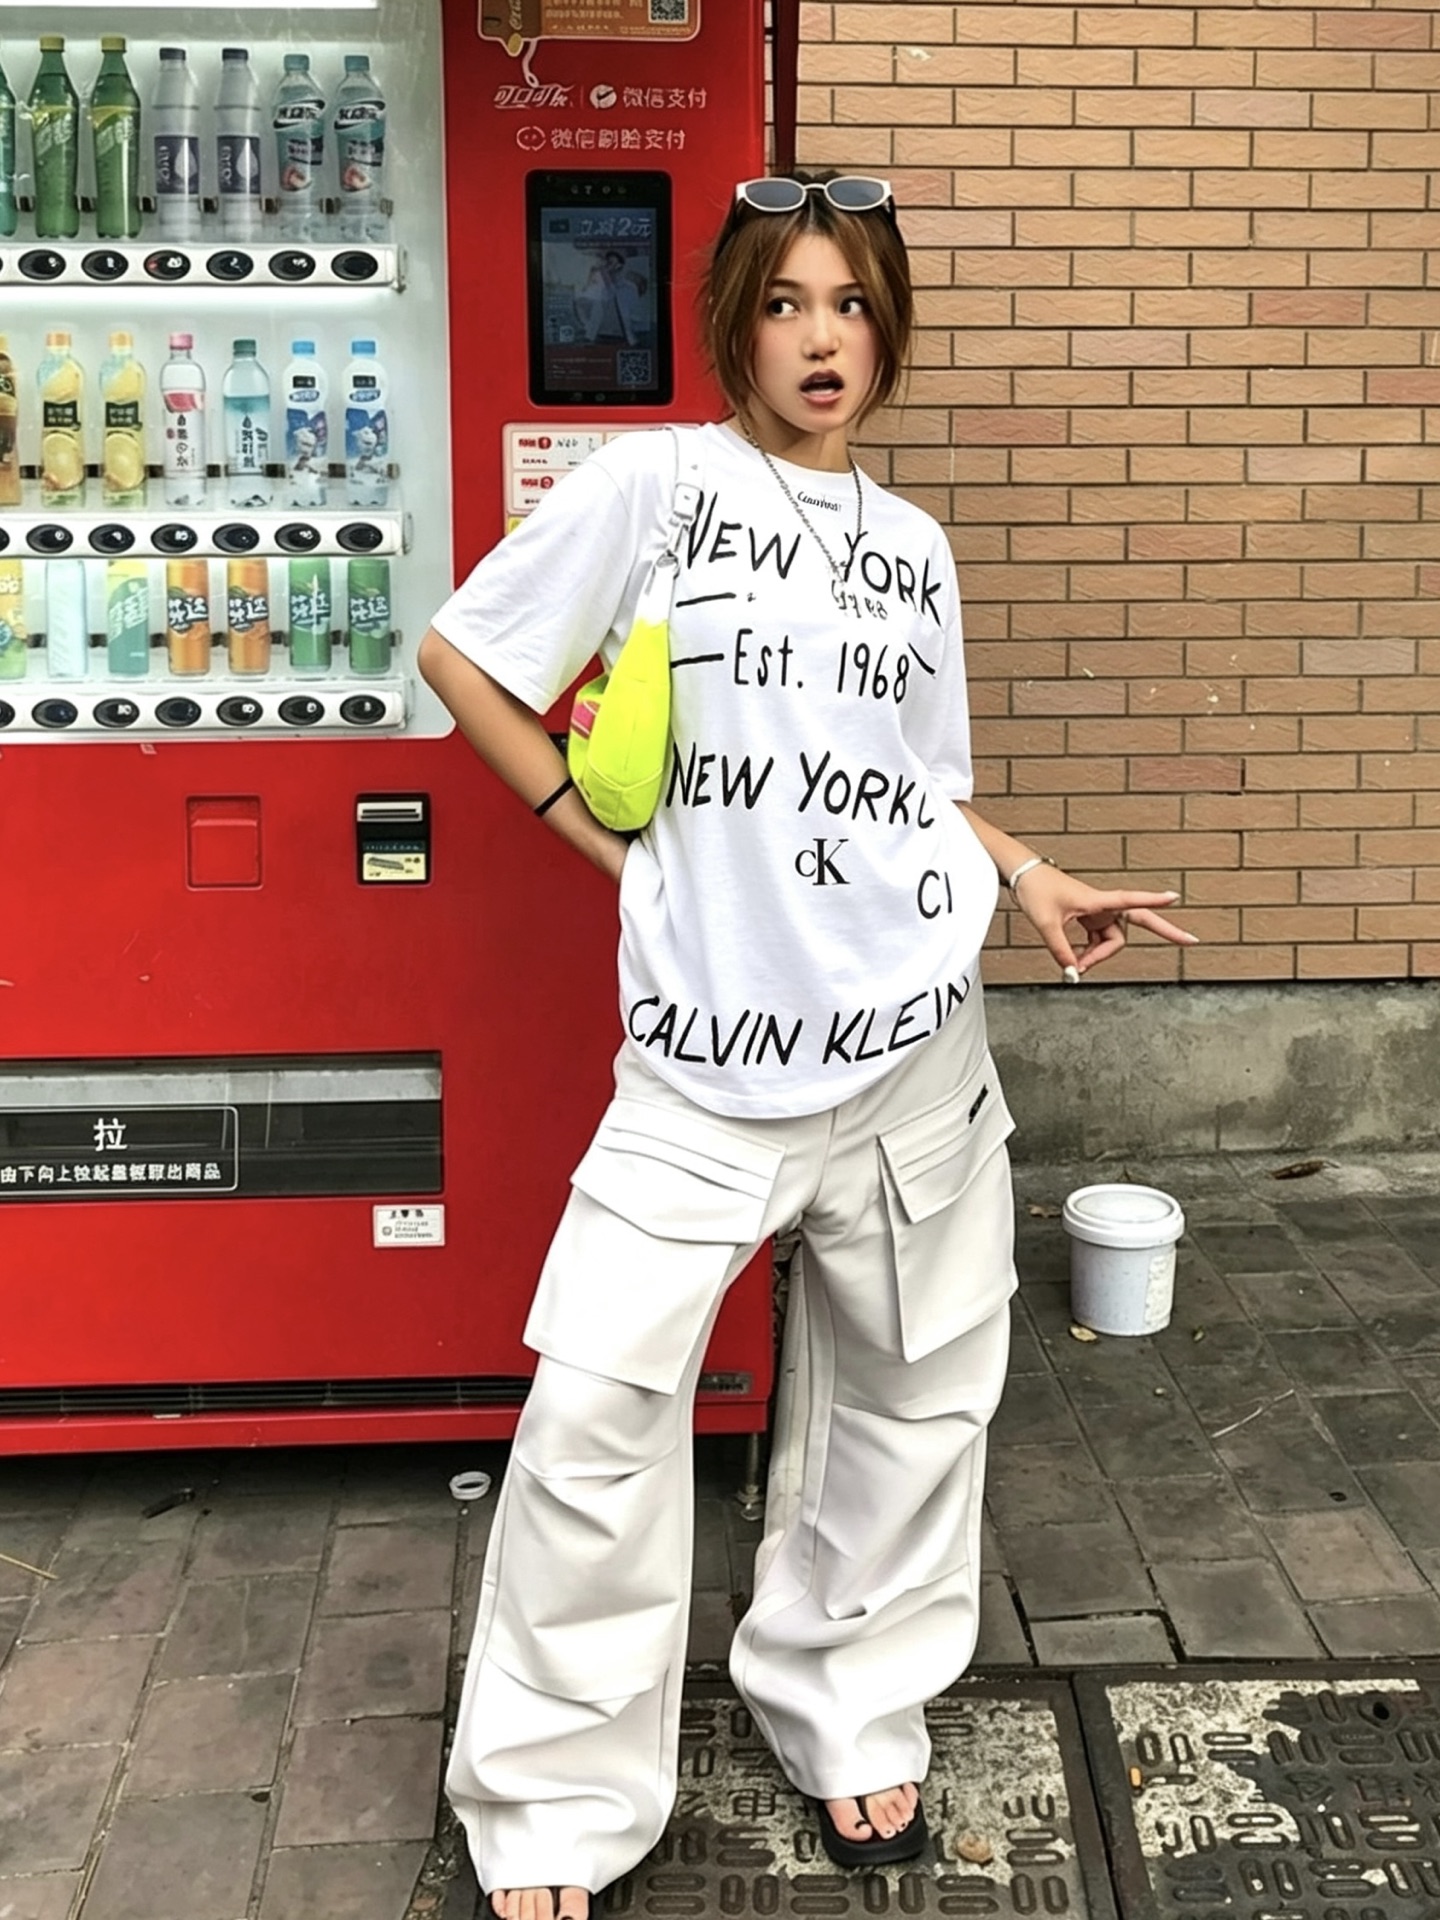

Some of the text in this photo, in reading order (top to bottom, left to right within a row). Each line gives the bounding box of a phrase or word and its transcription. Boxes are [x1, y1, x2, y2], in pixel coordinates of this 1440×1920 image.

[622, 86, 707, 109] 微信支付
[550, 127, 686, 150] 微信刷脸支付
[687, 490, 801, 580] NEW
[844, 531, 943, 630] YORK
[733, 628, 910, 704] Est. 1968
[665, 741, 774, 809] NEW
[628, 975, 970, 1067] CALVIN KLEIN
[93, 1117, 128, 1151] 拉
